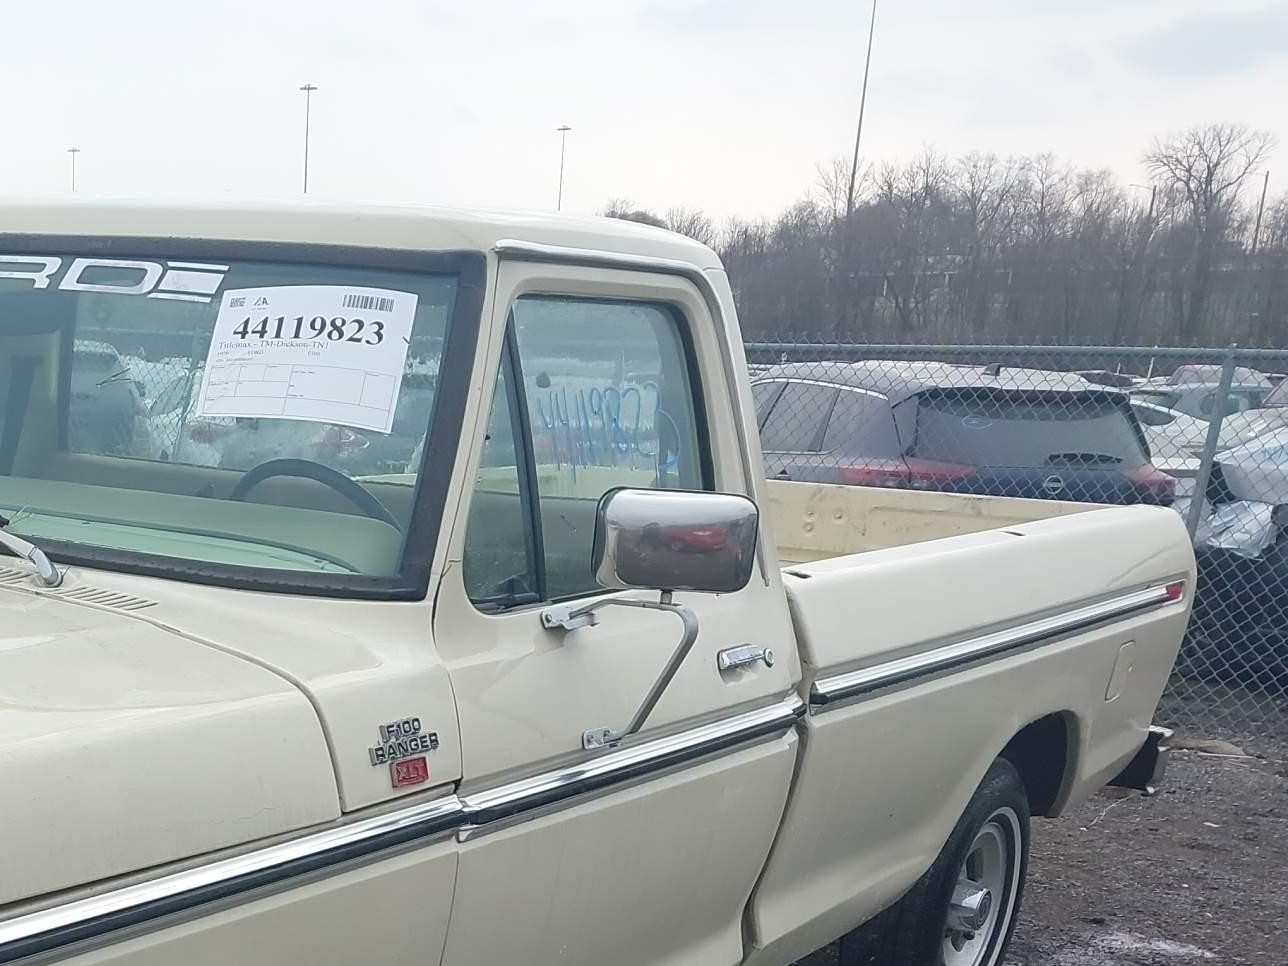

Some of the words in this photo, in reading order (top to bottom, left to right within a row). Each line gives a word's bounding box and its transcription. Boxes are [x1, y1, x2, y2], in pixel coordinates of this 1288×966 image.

[232, 315, 385, 346] 44119823
[379, 718, 422, 742] F100
[369, 731, 440, 766] RANGER
